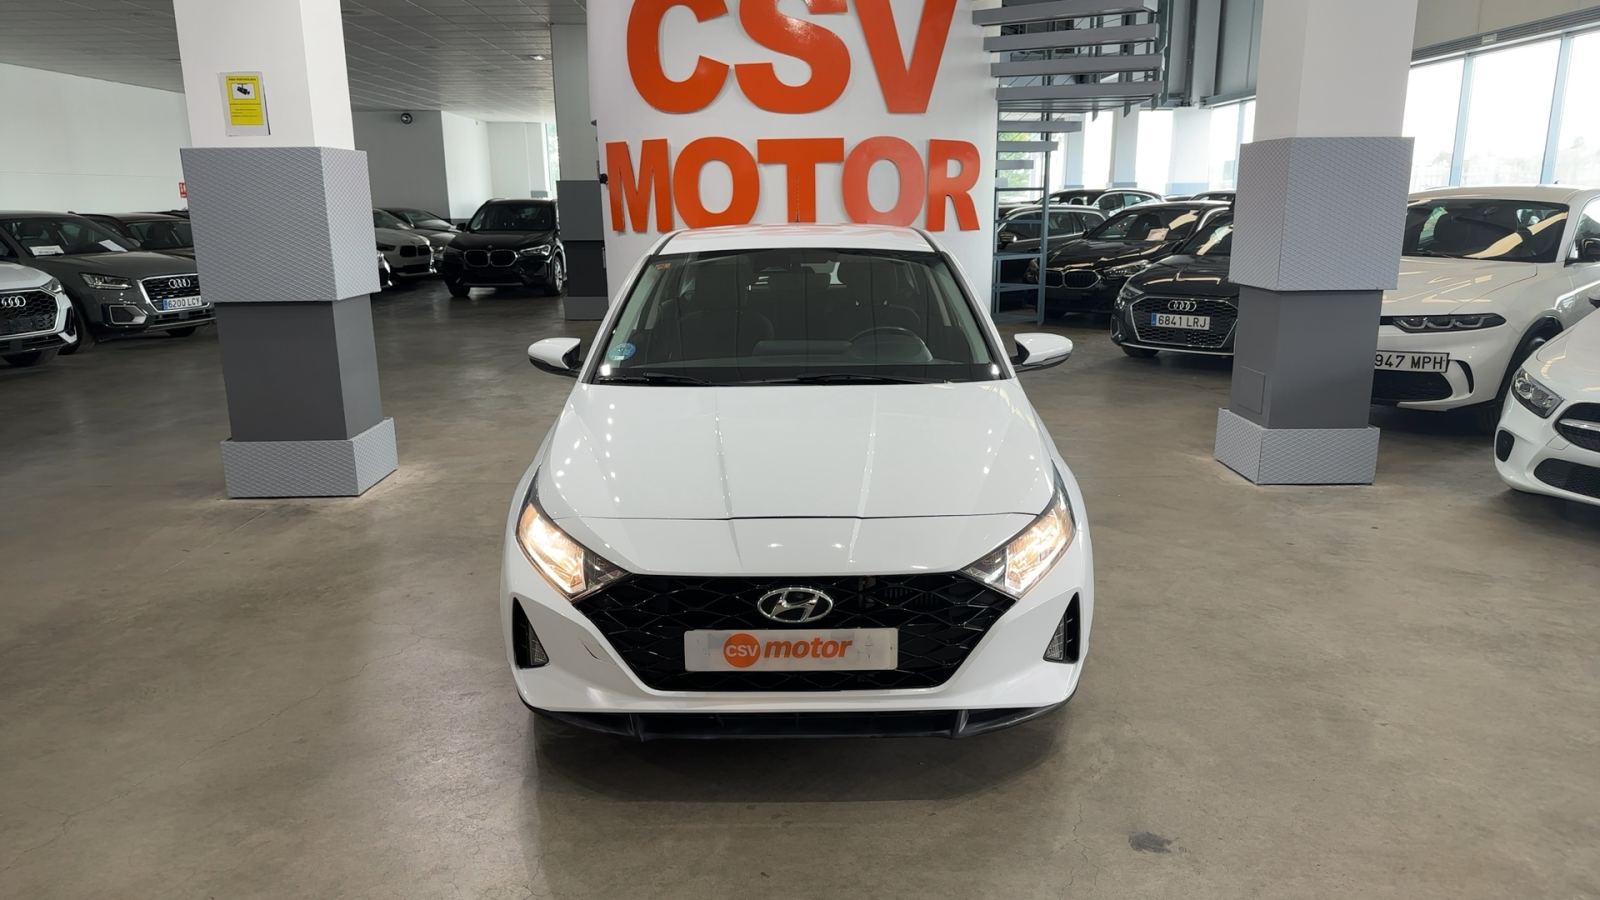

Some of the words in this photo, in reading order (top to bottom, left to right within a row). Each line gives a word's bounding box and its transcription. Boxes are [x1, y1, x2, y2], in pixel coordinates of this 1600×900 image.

[627, 0, 957, 114] CSV
[606, 136, 981, 233] MOTOR
[168, 299, 186, 308] 6200
[1158, 315, 1182, 326] 6841
[1186, 317, 1207, 328] LRJ
[1411, 355, 1443, 370] MPH
[764, 637, 853, 659] motor
